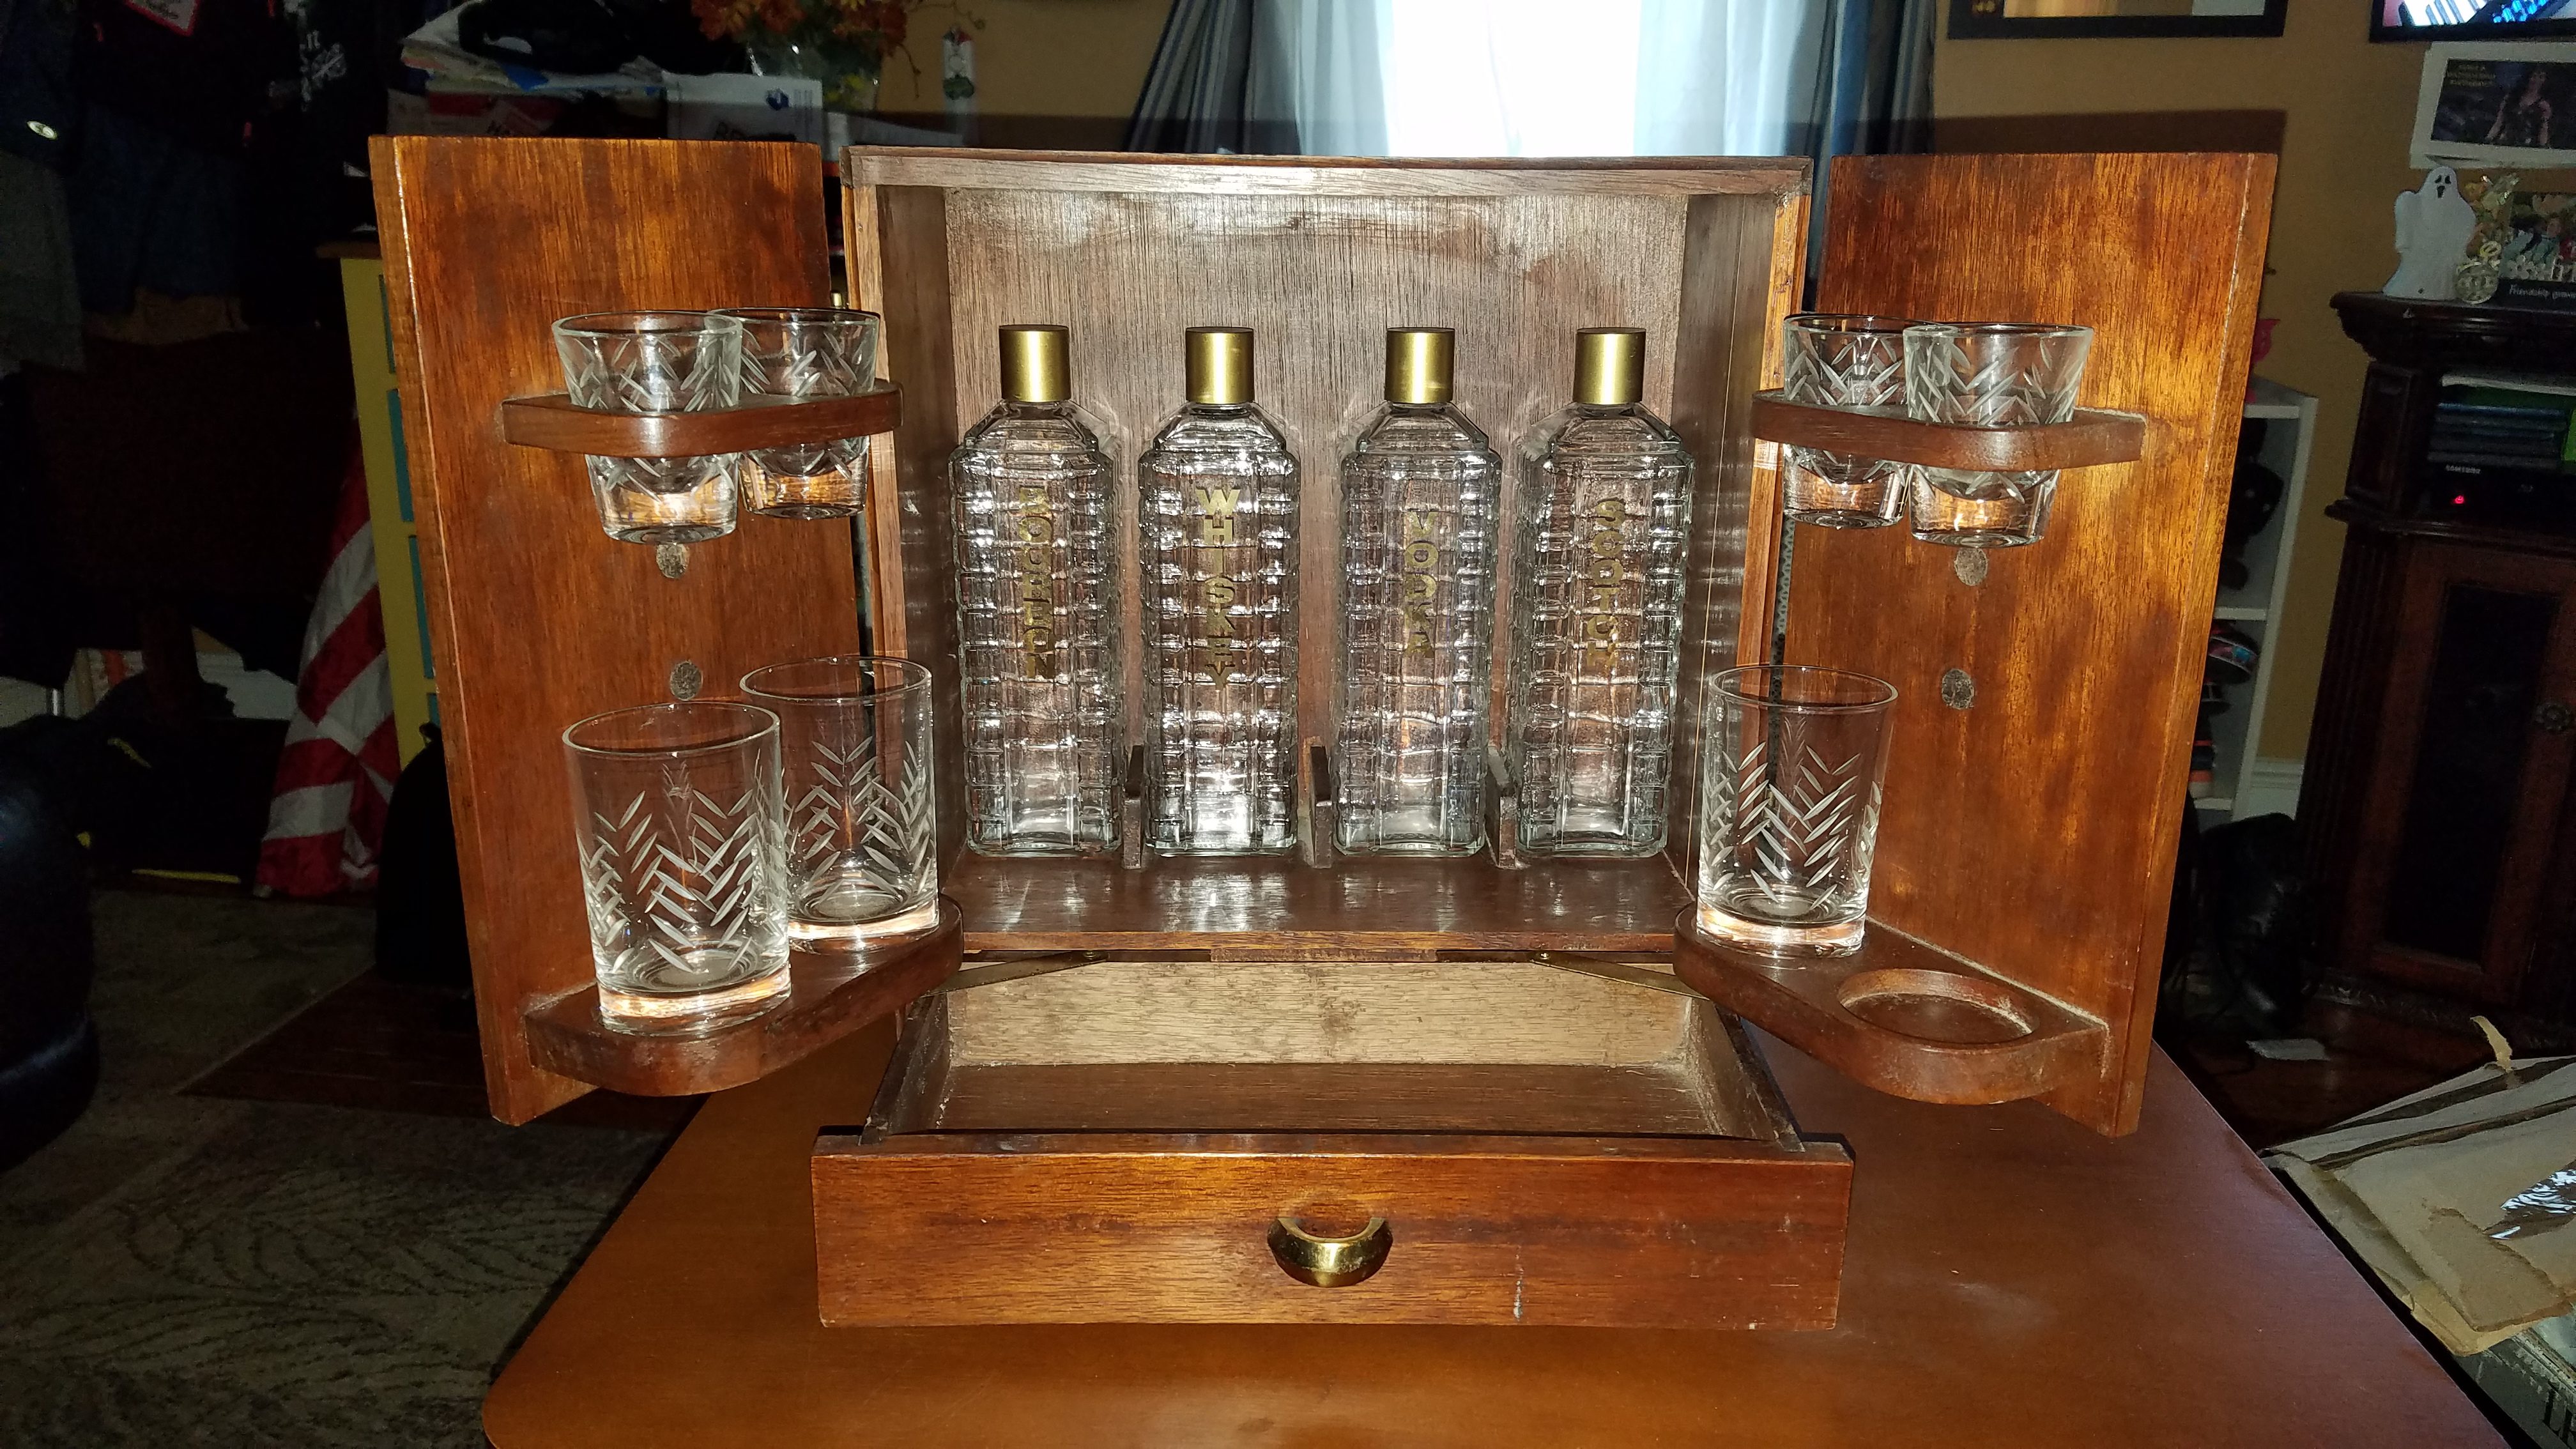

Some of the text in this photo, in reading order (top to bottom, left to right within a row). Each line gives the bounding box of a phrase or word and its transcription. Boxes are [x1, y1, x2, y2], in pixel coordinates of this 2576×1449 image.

[1018, 485, 1056, 680] BOURBON
[1197, 486, 1241, 691] WHISKEY
[1404, 510, 1439, 659] VODKA
[1586, 497, 1626, 668] SCOTCH
